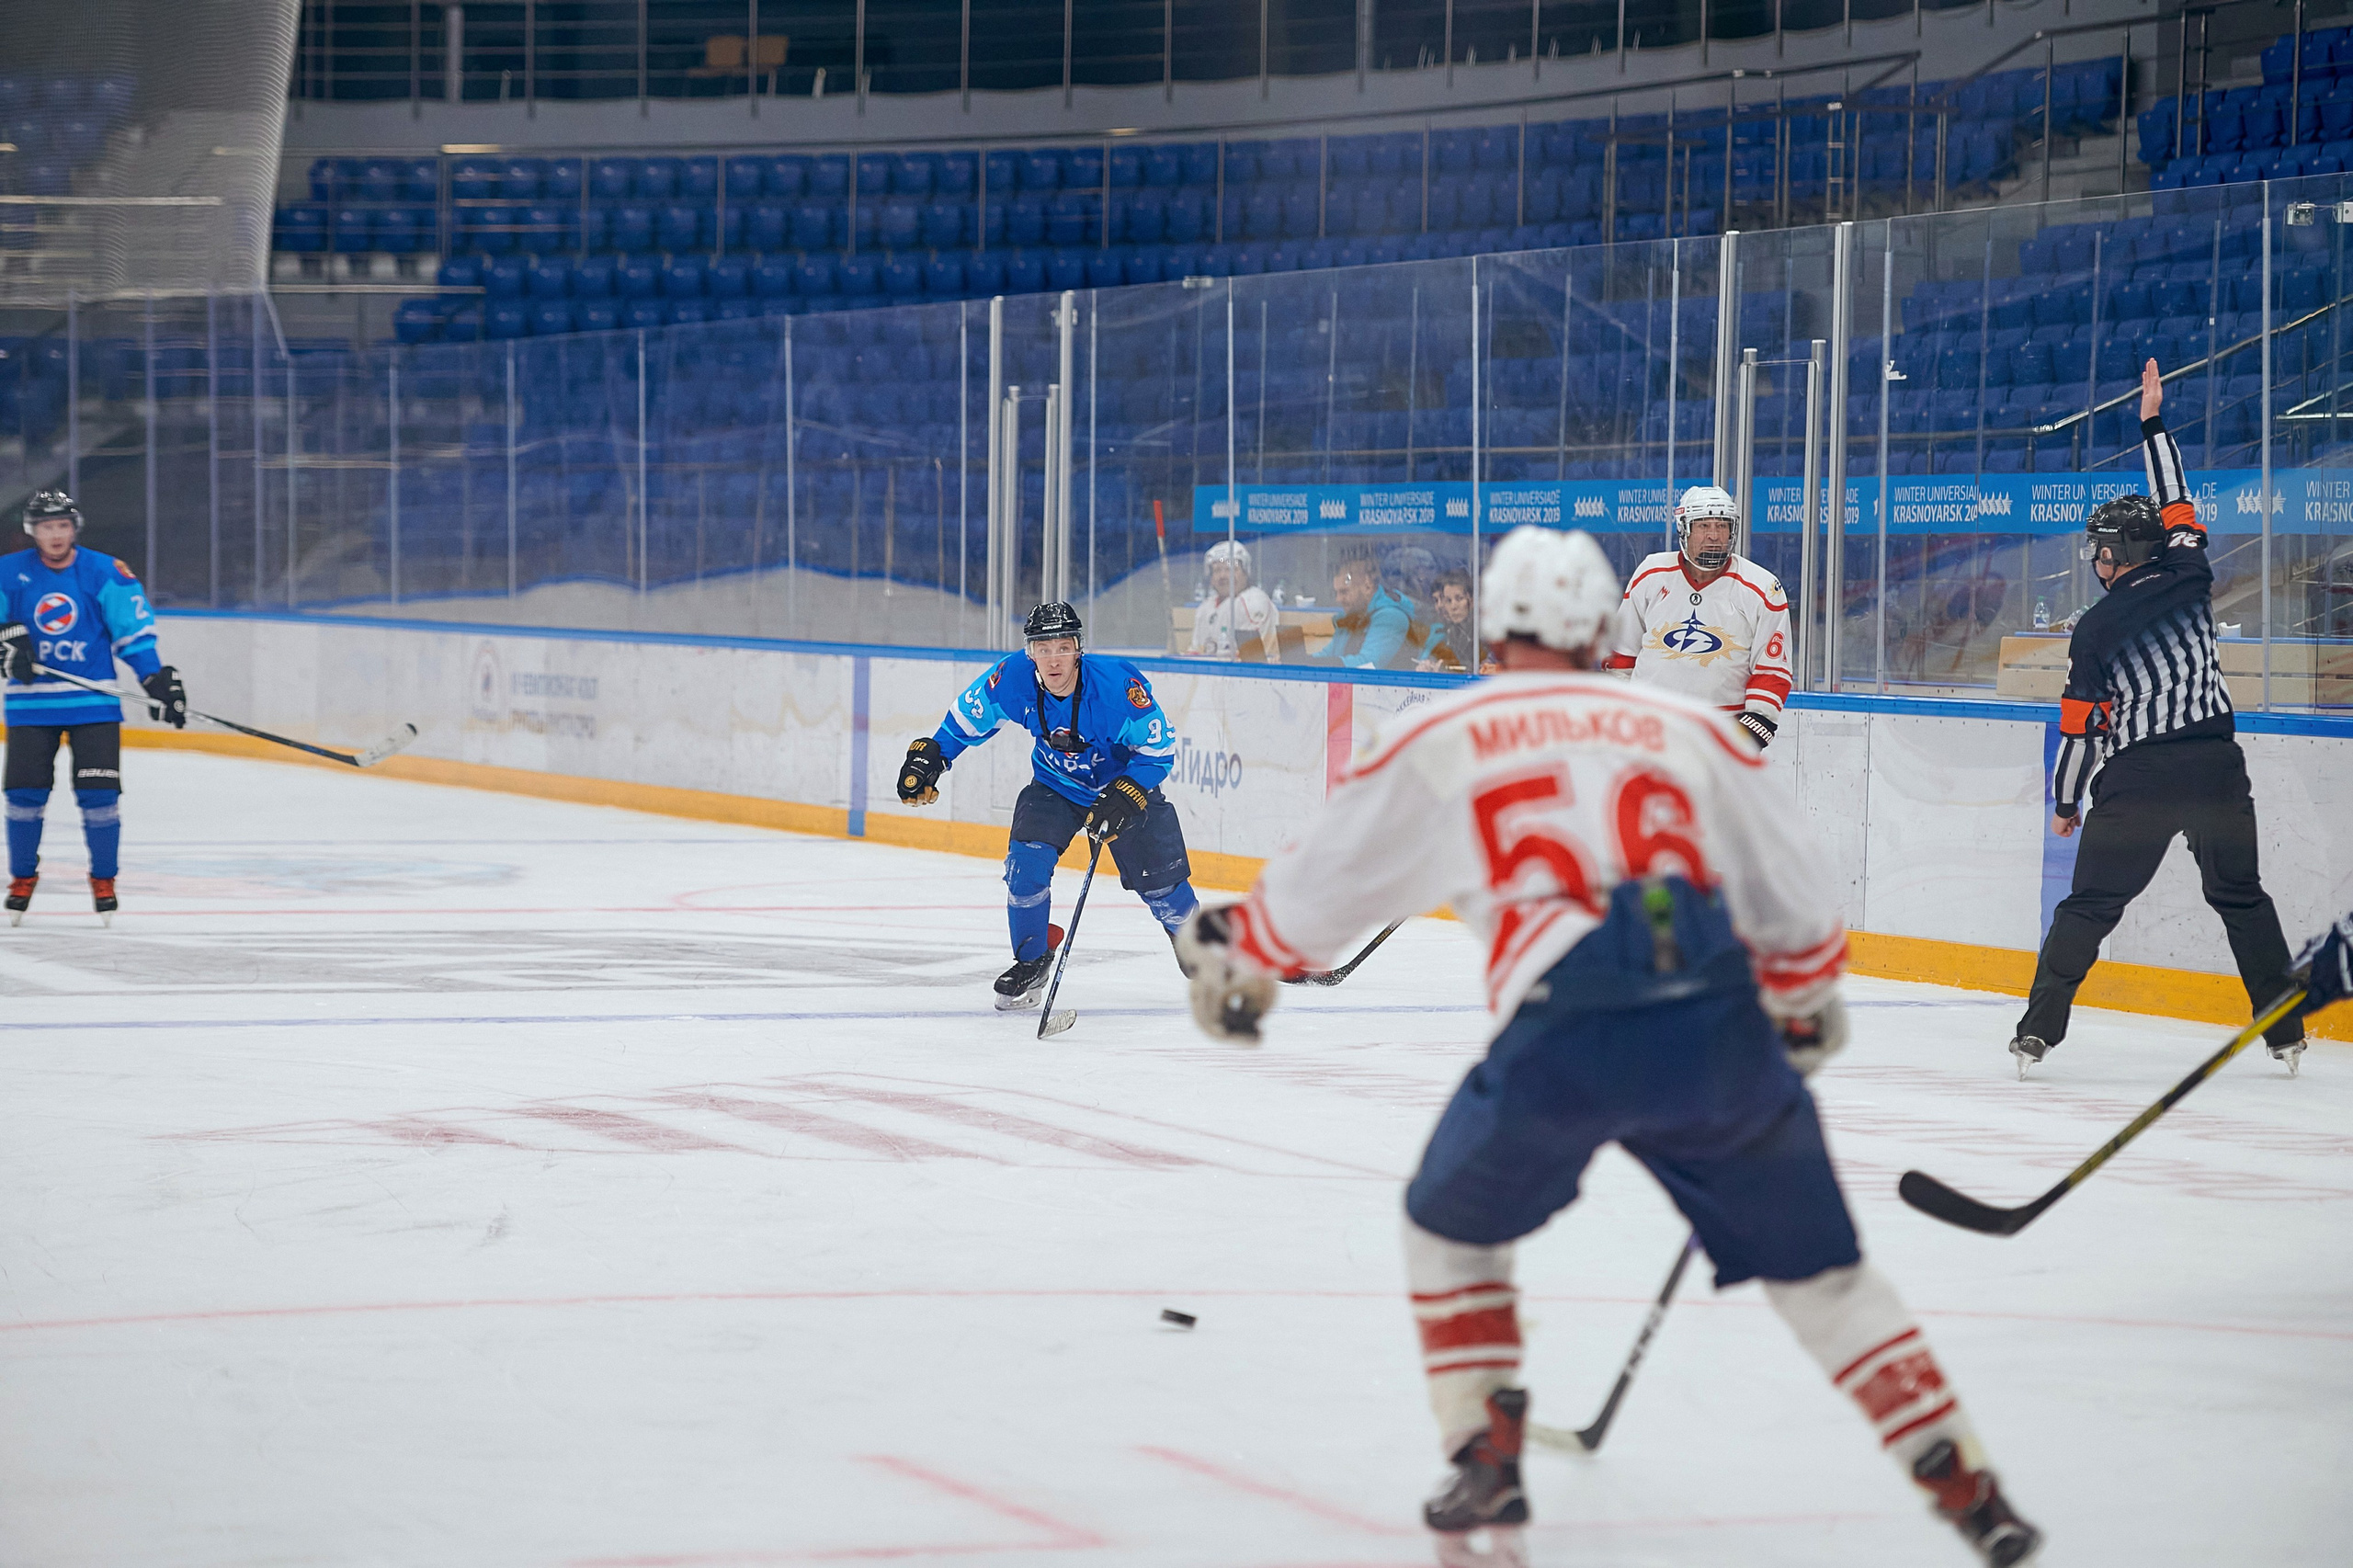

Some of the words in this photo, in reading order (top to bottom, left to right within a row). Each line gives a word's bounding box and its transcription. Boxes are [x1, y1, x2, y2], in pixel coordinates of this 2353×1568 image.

[1489, 490, 1515, 506] WINTER
[1619, 489, 1647, 504] WINTER
[1768, 487, 1802, 503] WINTER
[1894, 486, 1926, 502] WINTER
[2032, 484, 2071, 501] WINTER
[2073, 483, 2139, 500] UNVERSIADE
[2305, 481, 2350, 498] WINTER
[1359, 492, 1388, 506] WINTER
[1418, 506, 1435, 524] 2019
[1489, 506, 1541, 523] KRASNOYARSK
[1618, 506, 1668, 523] KRASNOYARS
[1893, 504, 1962, 523] KRASNOYARSK
[39, 640, 88, 662] РСК
[1468, 707, 1665, 763] МИЛЬКОВ
[1170, 737, 1242, 799] сГидро
